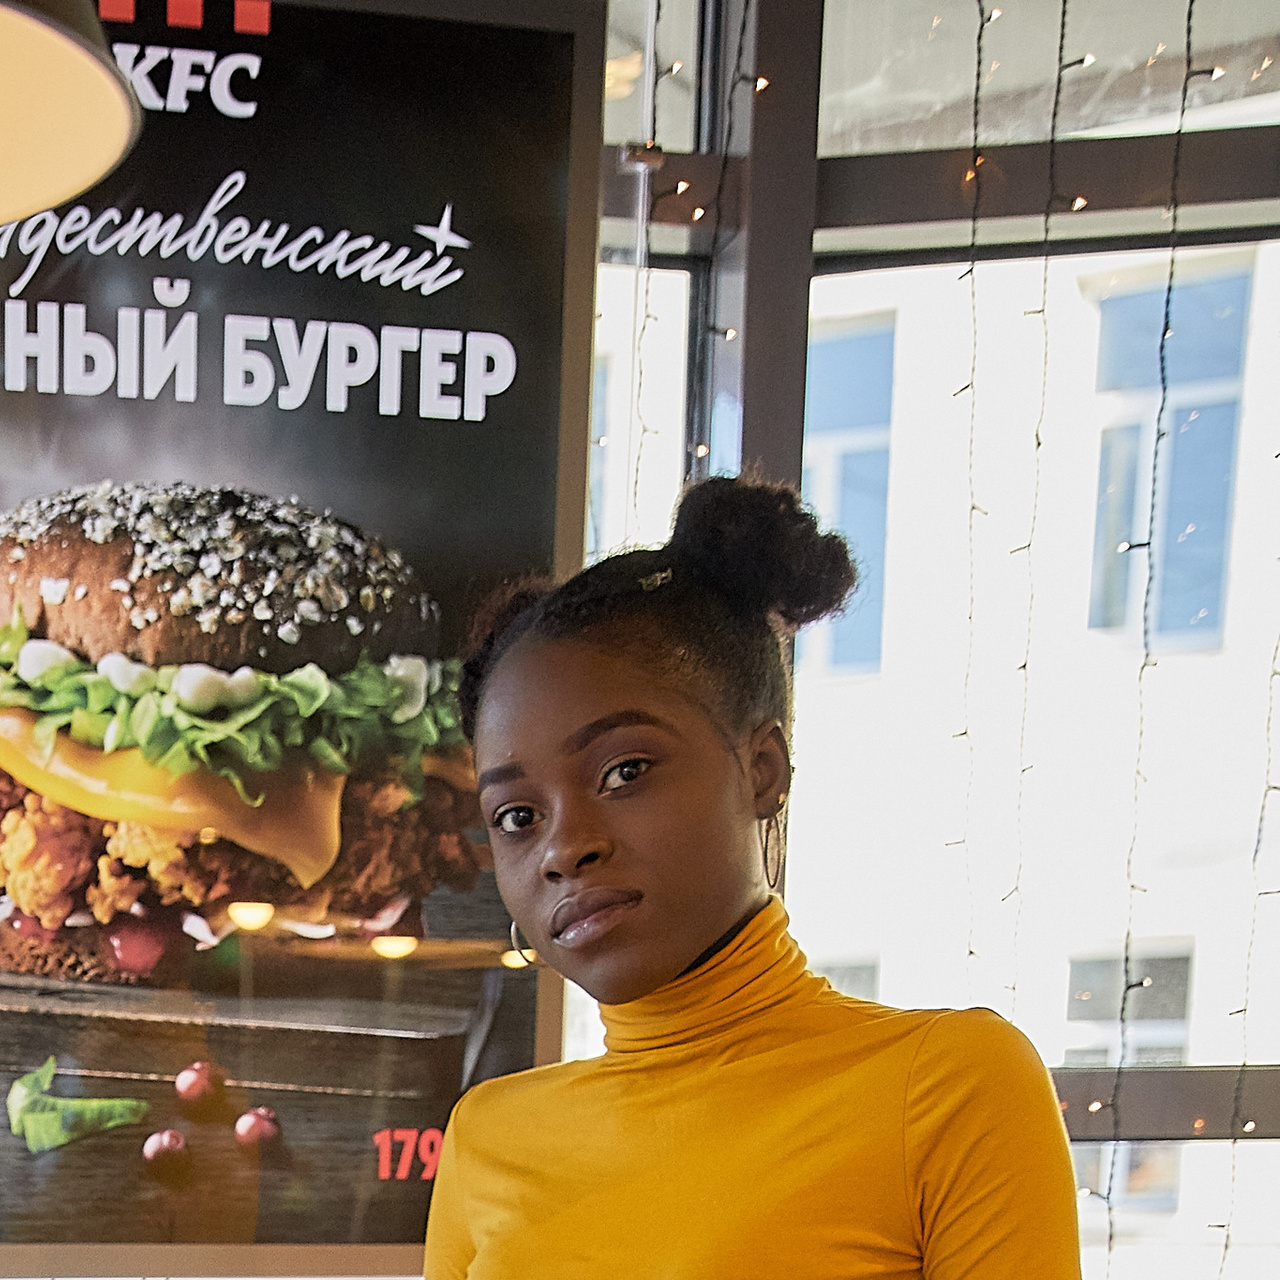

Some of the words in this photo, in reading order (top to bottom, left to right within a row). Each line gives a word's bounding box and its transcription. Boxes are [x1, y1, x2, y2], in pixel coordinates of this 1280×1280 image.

[112, 42, 263, 119] KFC
[222, 313, 518, 422] БУРГЕР
[372, 1126, 445, 1181] 179
